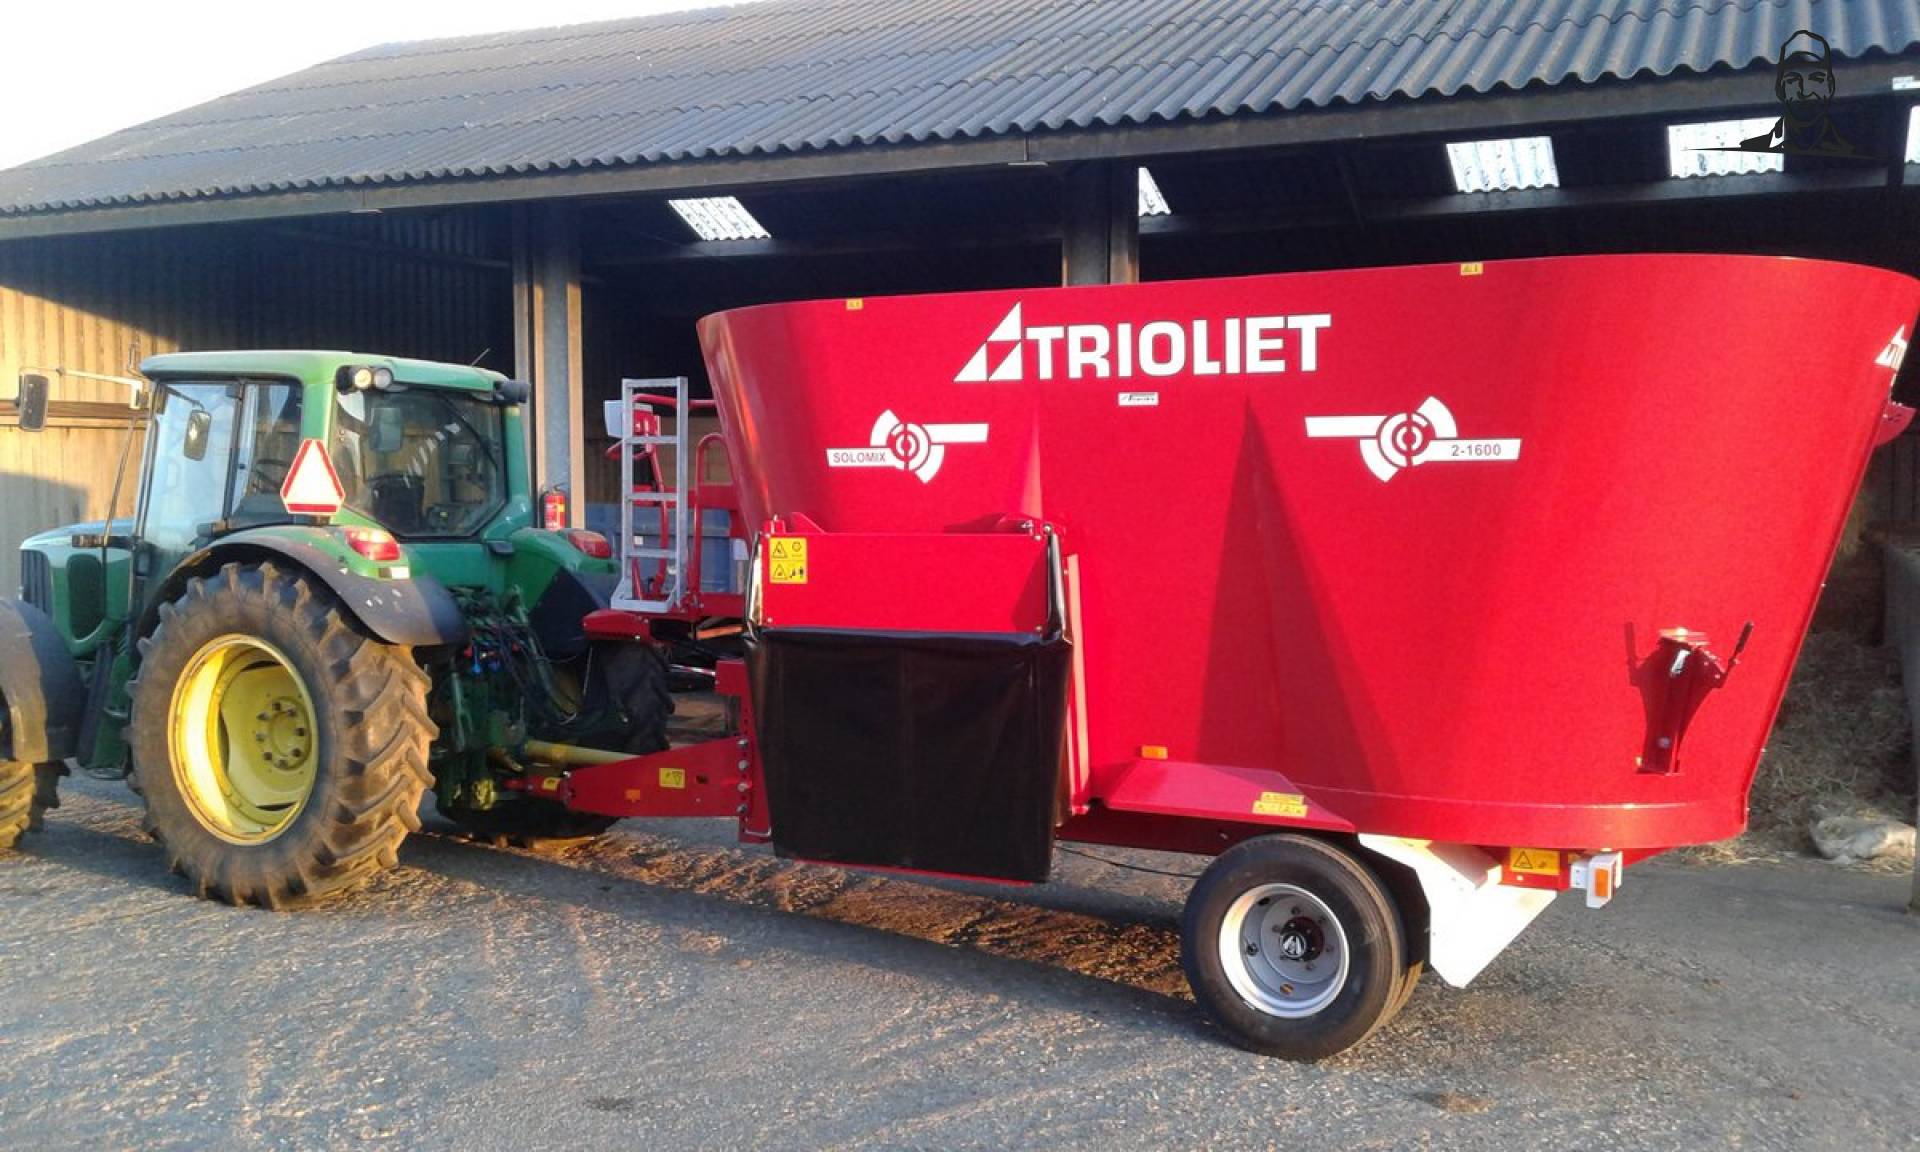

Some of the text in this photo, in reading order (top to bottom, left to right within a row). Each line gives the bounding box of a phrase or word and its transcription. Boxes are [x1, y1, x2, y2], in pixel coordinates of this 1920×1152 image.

[1026, 314, 1331, 380] TRIOLIET
[1451, 443, 1502, 457] 2-1600
[832, 451, 887, 464] SOLOMIX
